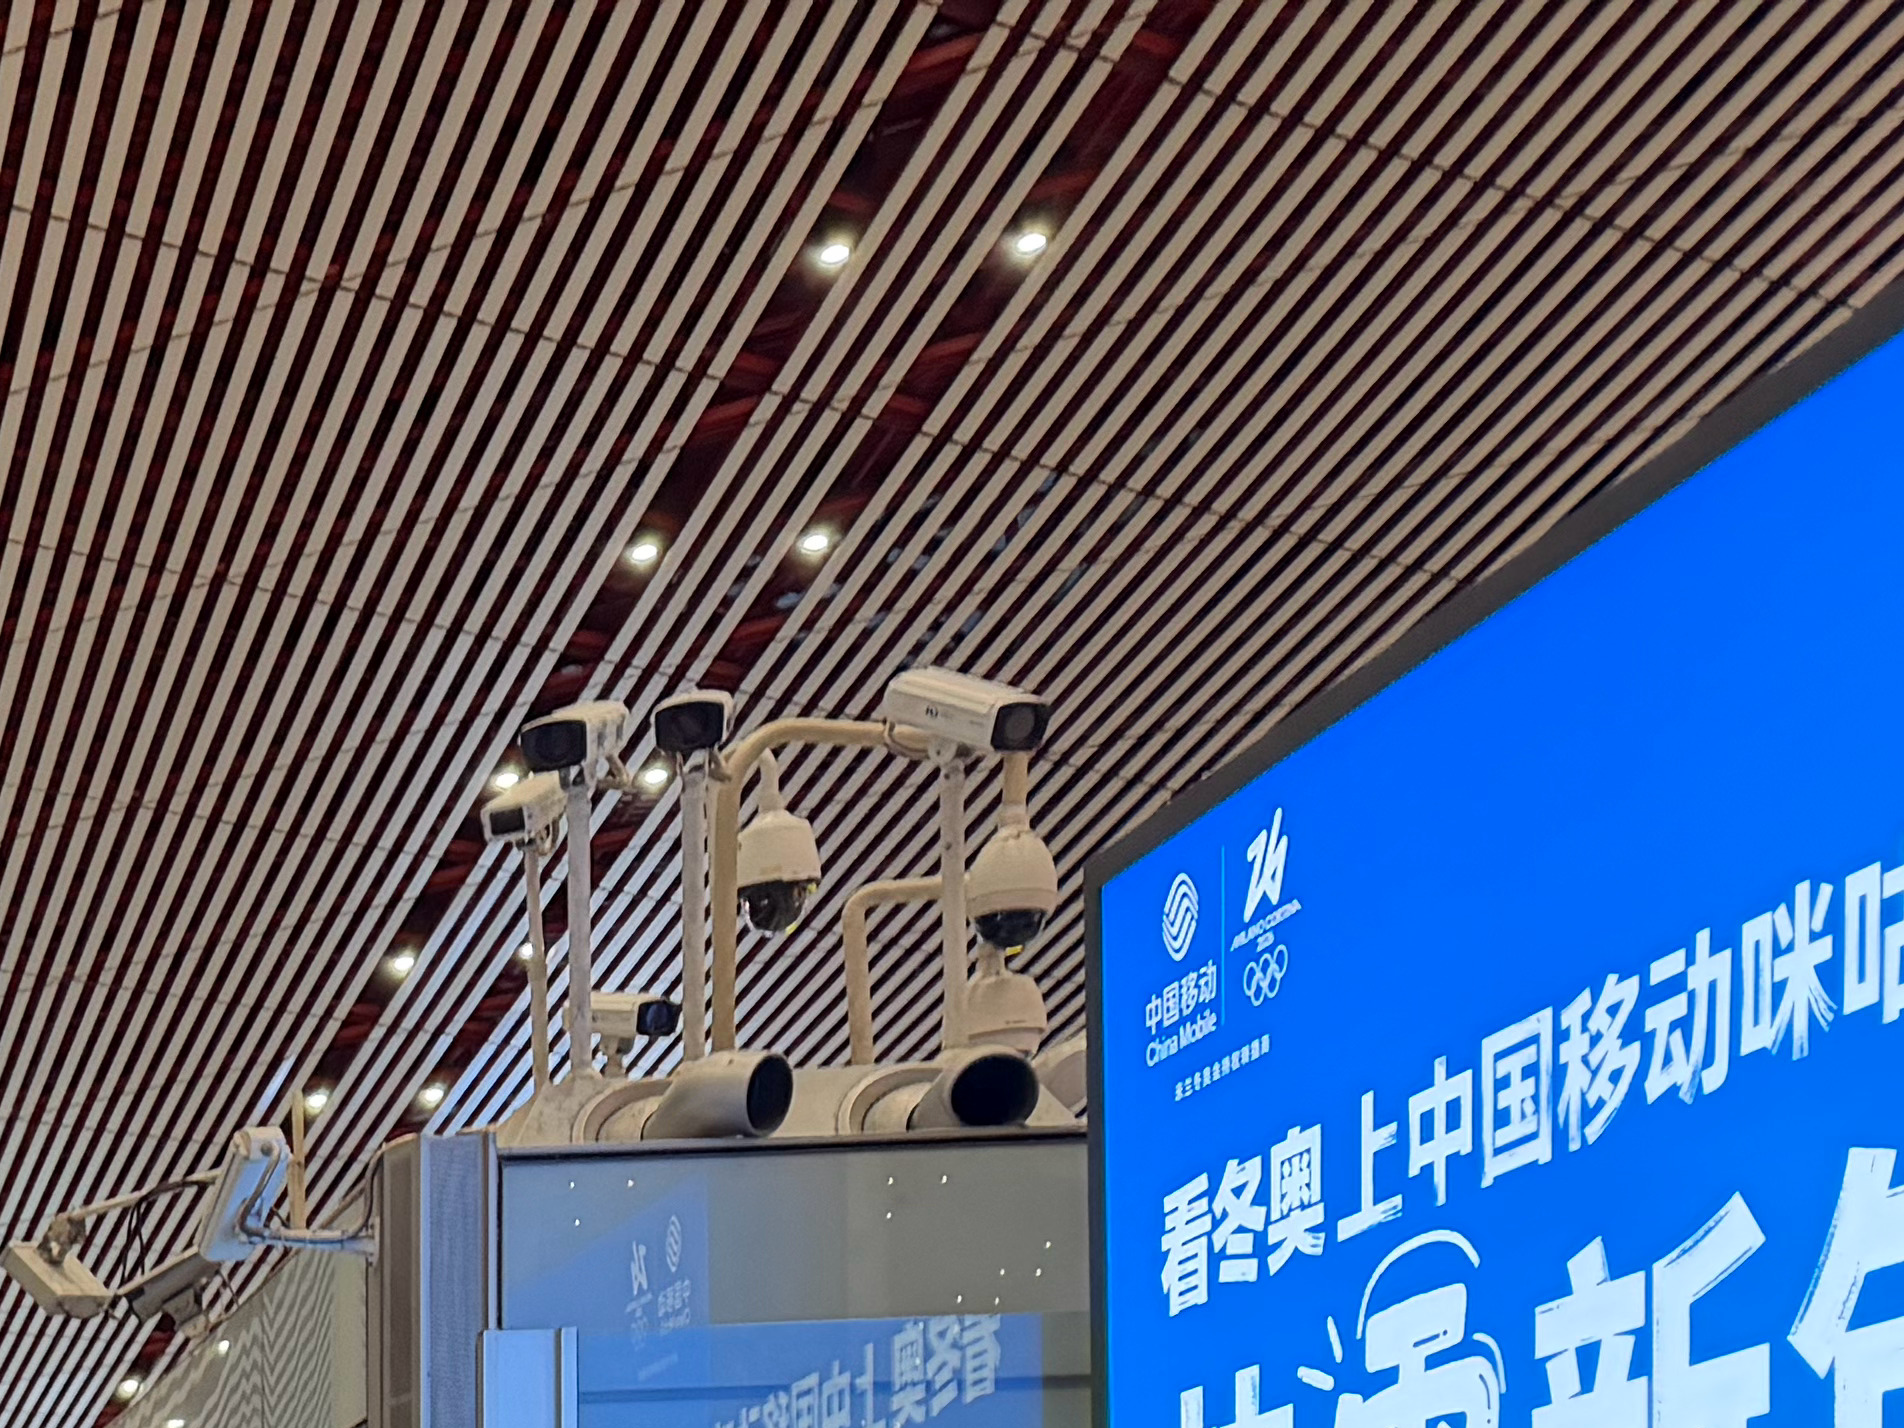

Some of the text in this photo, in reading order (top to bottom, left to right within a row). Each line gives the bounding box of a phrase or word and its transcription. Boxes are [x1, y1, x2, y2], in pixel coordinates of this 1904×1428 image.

[1145, 959, 1217, 1034] 中国移动
[1146, 1008, 1218, 1067] China Mobile
